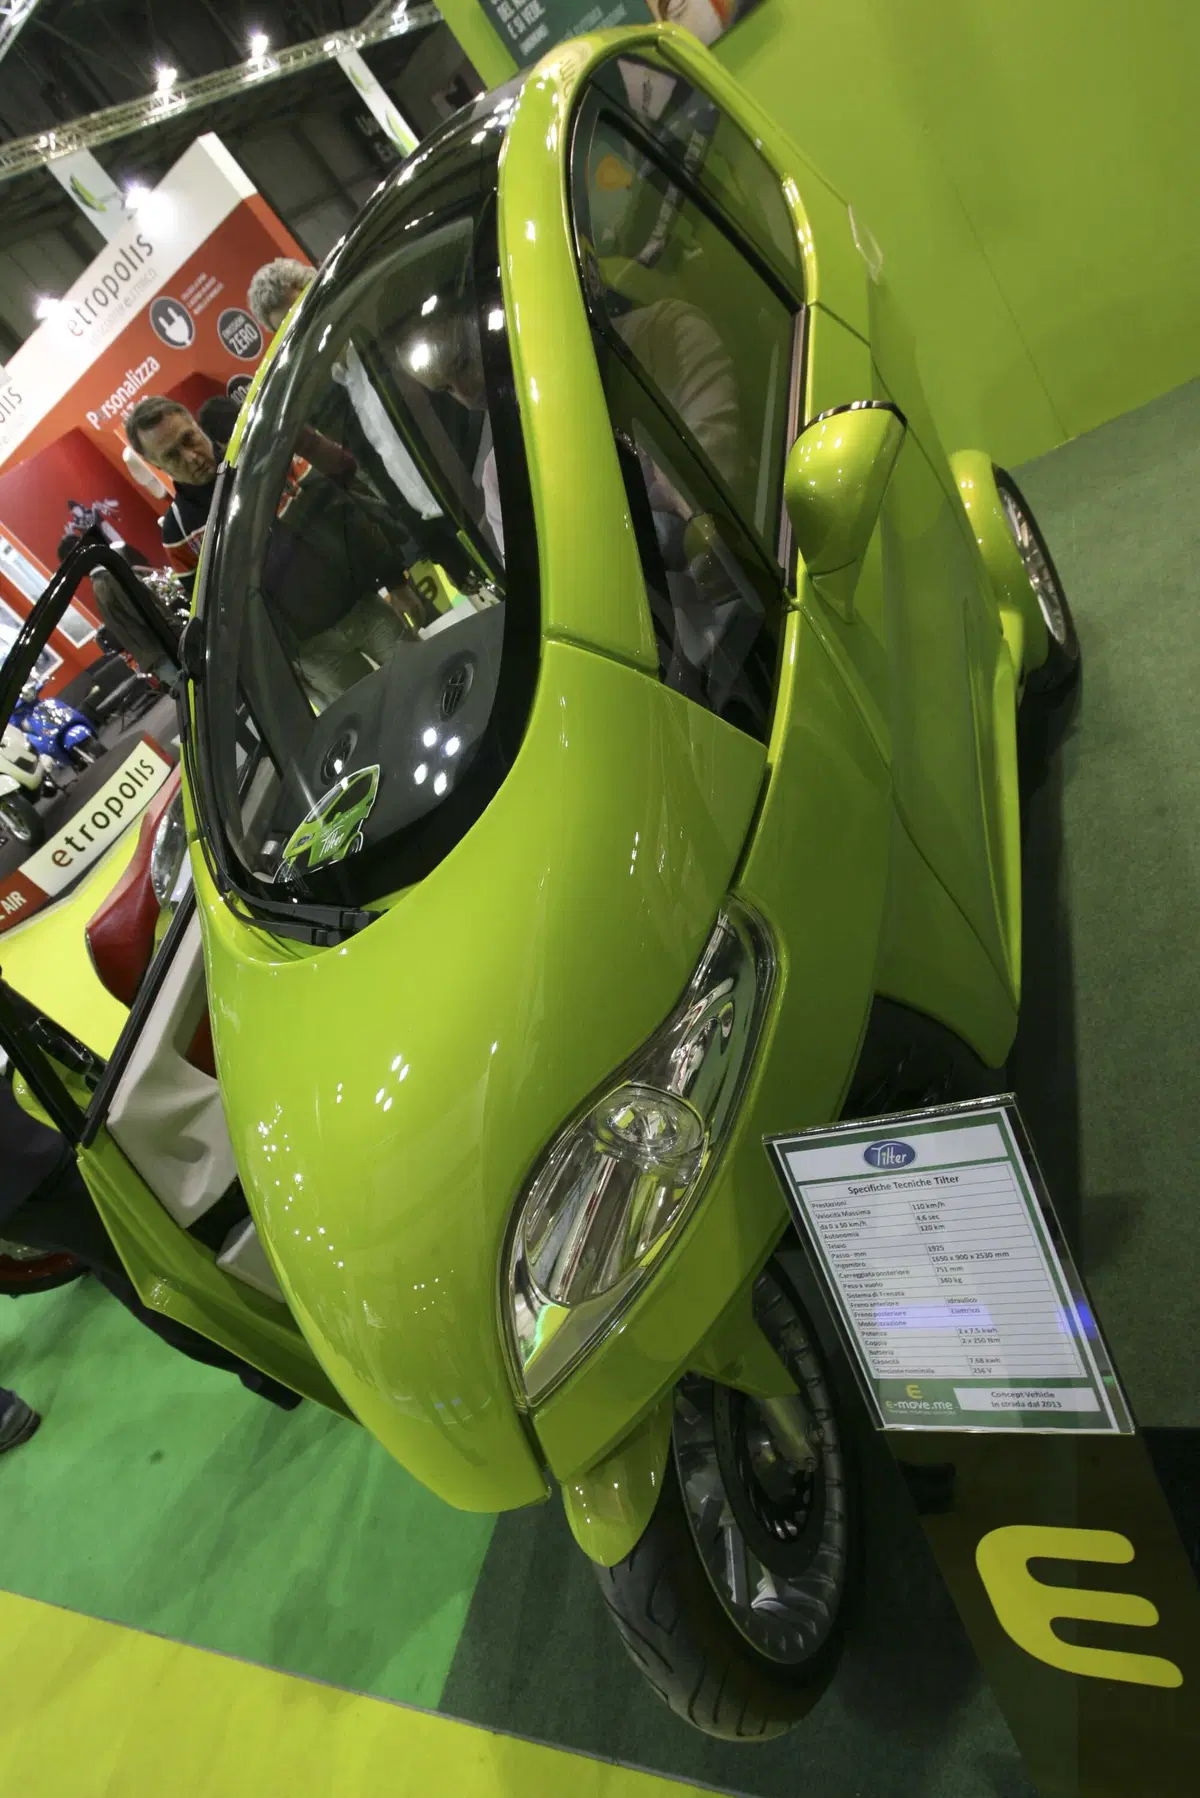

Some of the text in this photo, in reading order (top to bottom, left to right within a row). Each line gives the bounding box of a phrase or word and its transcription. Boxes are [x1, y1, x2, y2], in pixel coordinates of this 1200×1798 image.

[67, 234, 153, 336] etropolis
[228, 323, 259, 355] ZERO
[85, 356, 161, 430] Prsonalizza
[51, 759, 155, 867] etropolis
[1, 891, 27, 915] AIR
[870, 1142, 907, 1166] Tilter
[847, 1175, 960, 1195] Specifiche Tecniche Tilter
[912, 1201, 945, 1211] 110 km/h
[824, 1231, 860, 1239] Autonomia
[991, 1391, 1055, 1400] Concept Vehicle
